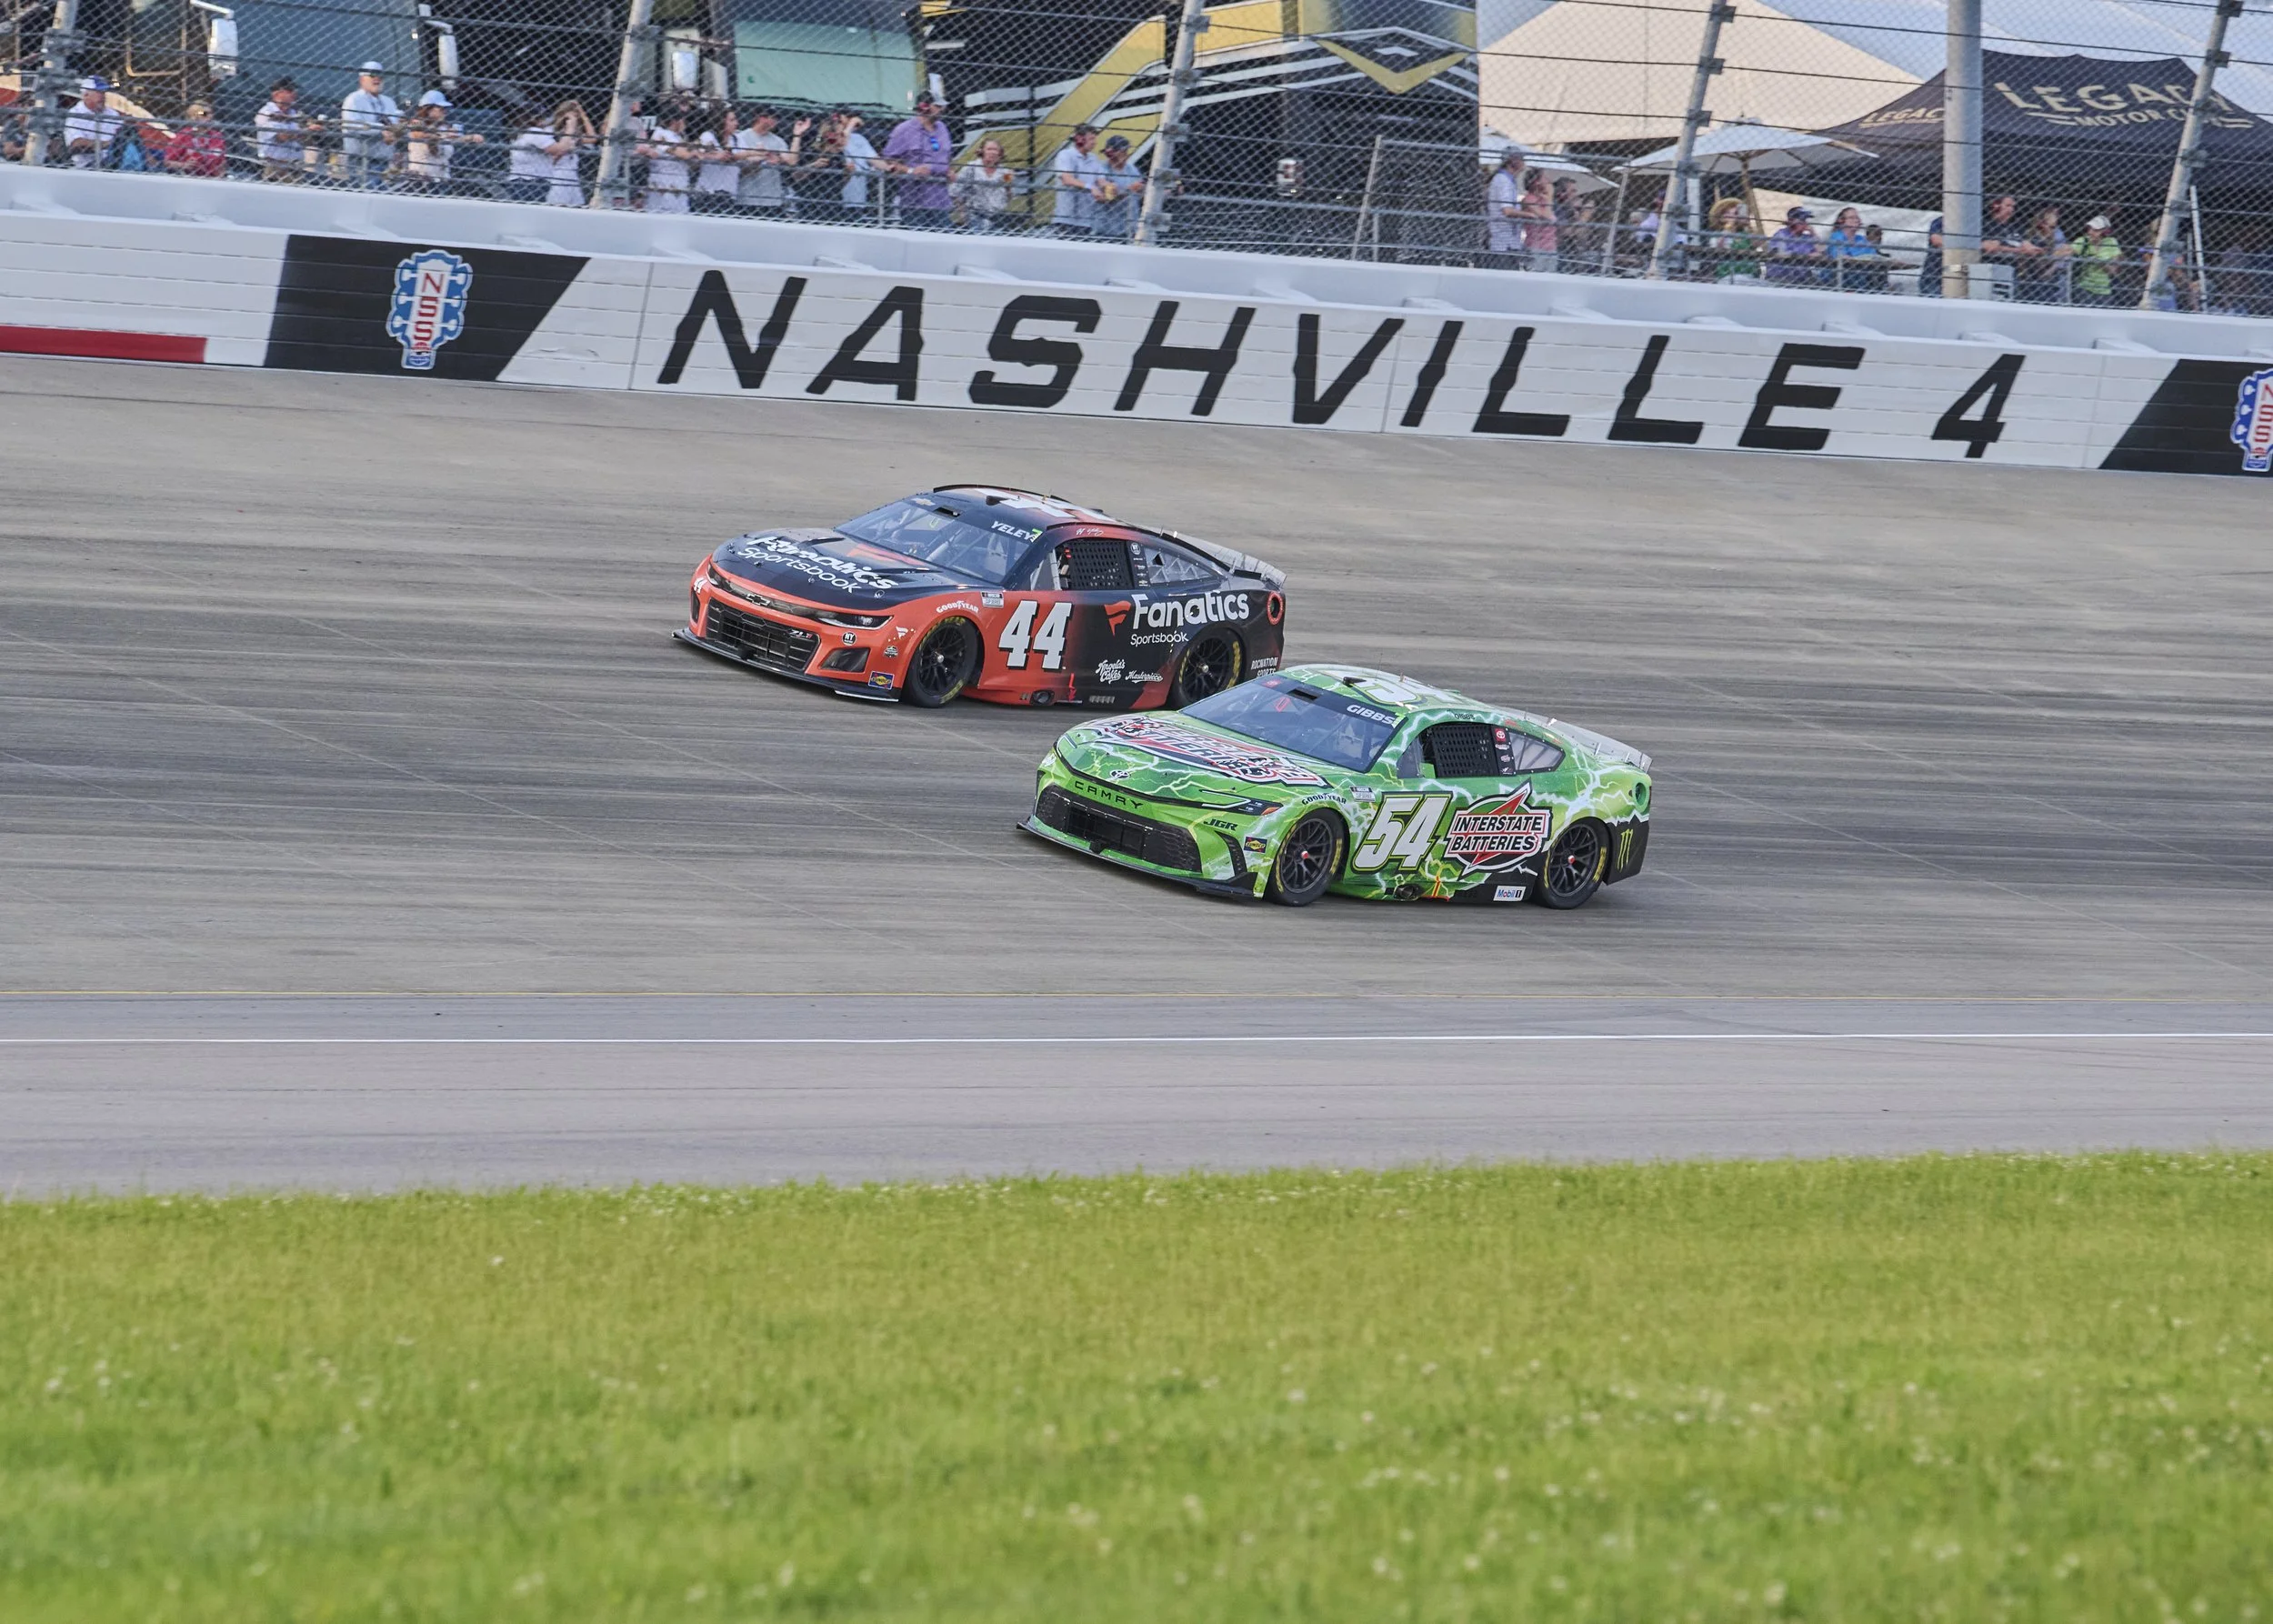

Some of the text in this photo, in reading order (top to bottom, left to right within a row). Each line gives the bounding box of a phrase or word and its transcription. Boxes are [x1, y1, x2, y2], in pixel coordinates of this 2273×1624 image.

[1861, 107, 1946, 124] LEGAC
[2075, 109, 2162, 127] MOTOR
[657, 269, 2025, 458] NASHVILLE 4
[737, 546, 863, 594] Sportsbook
[1131, 589, 1250, 630] Fanatics
[998, 599, 1075, 673] 44
[1130, 630, 1190, 647] Sportsbook
[1346, 704, 1395, 726] GIBBS
[1074, 780, 1144, 809] CAMRY
[1203, 818, 1238, 831] JGR
[1352, 792, 1452, 873] 54
[1455, 816, 1543, 832] INTERSTATE
[1450, 836, 1537, 851] BATTERIES
[1497, 888, 1515, 898] Mobil
